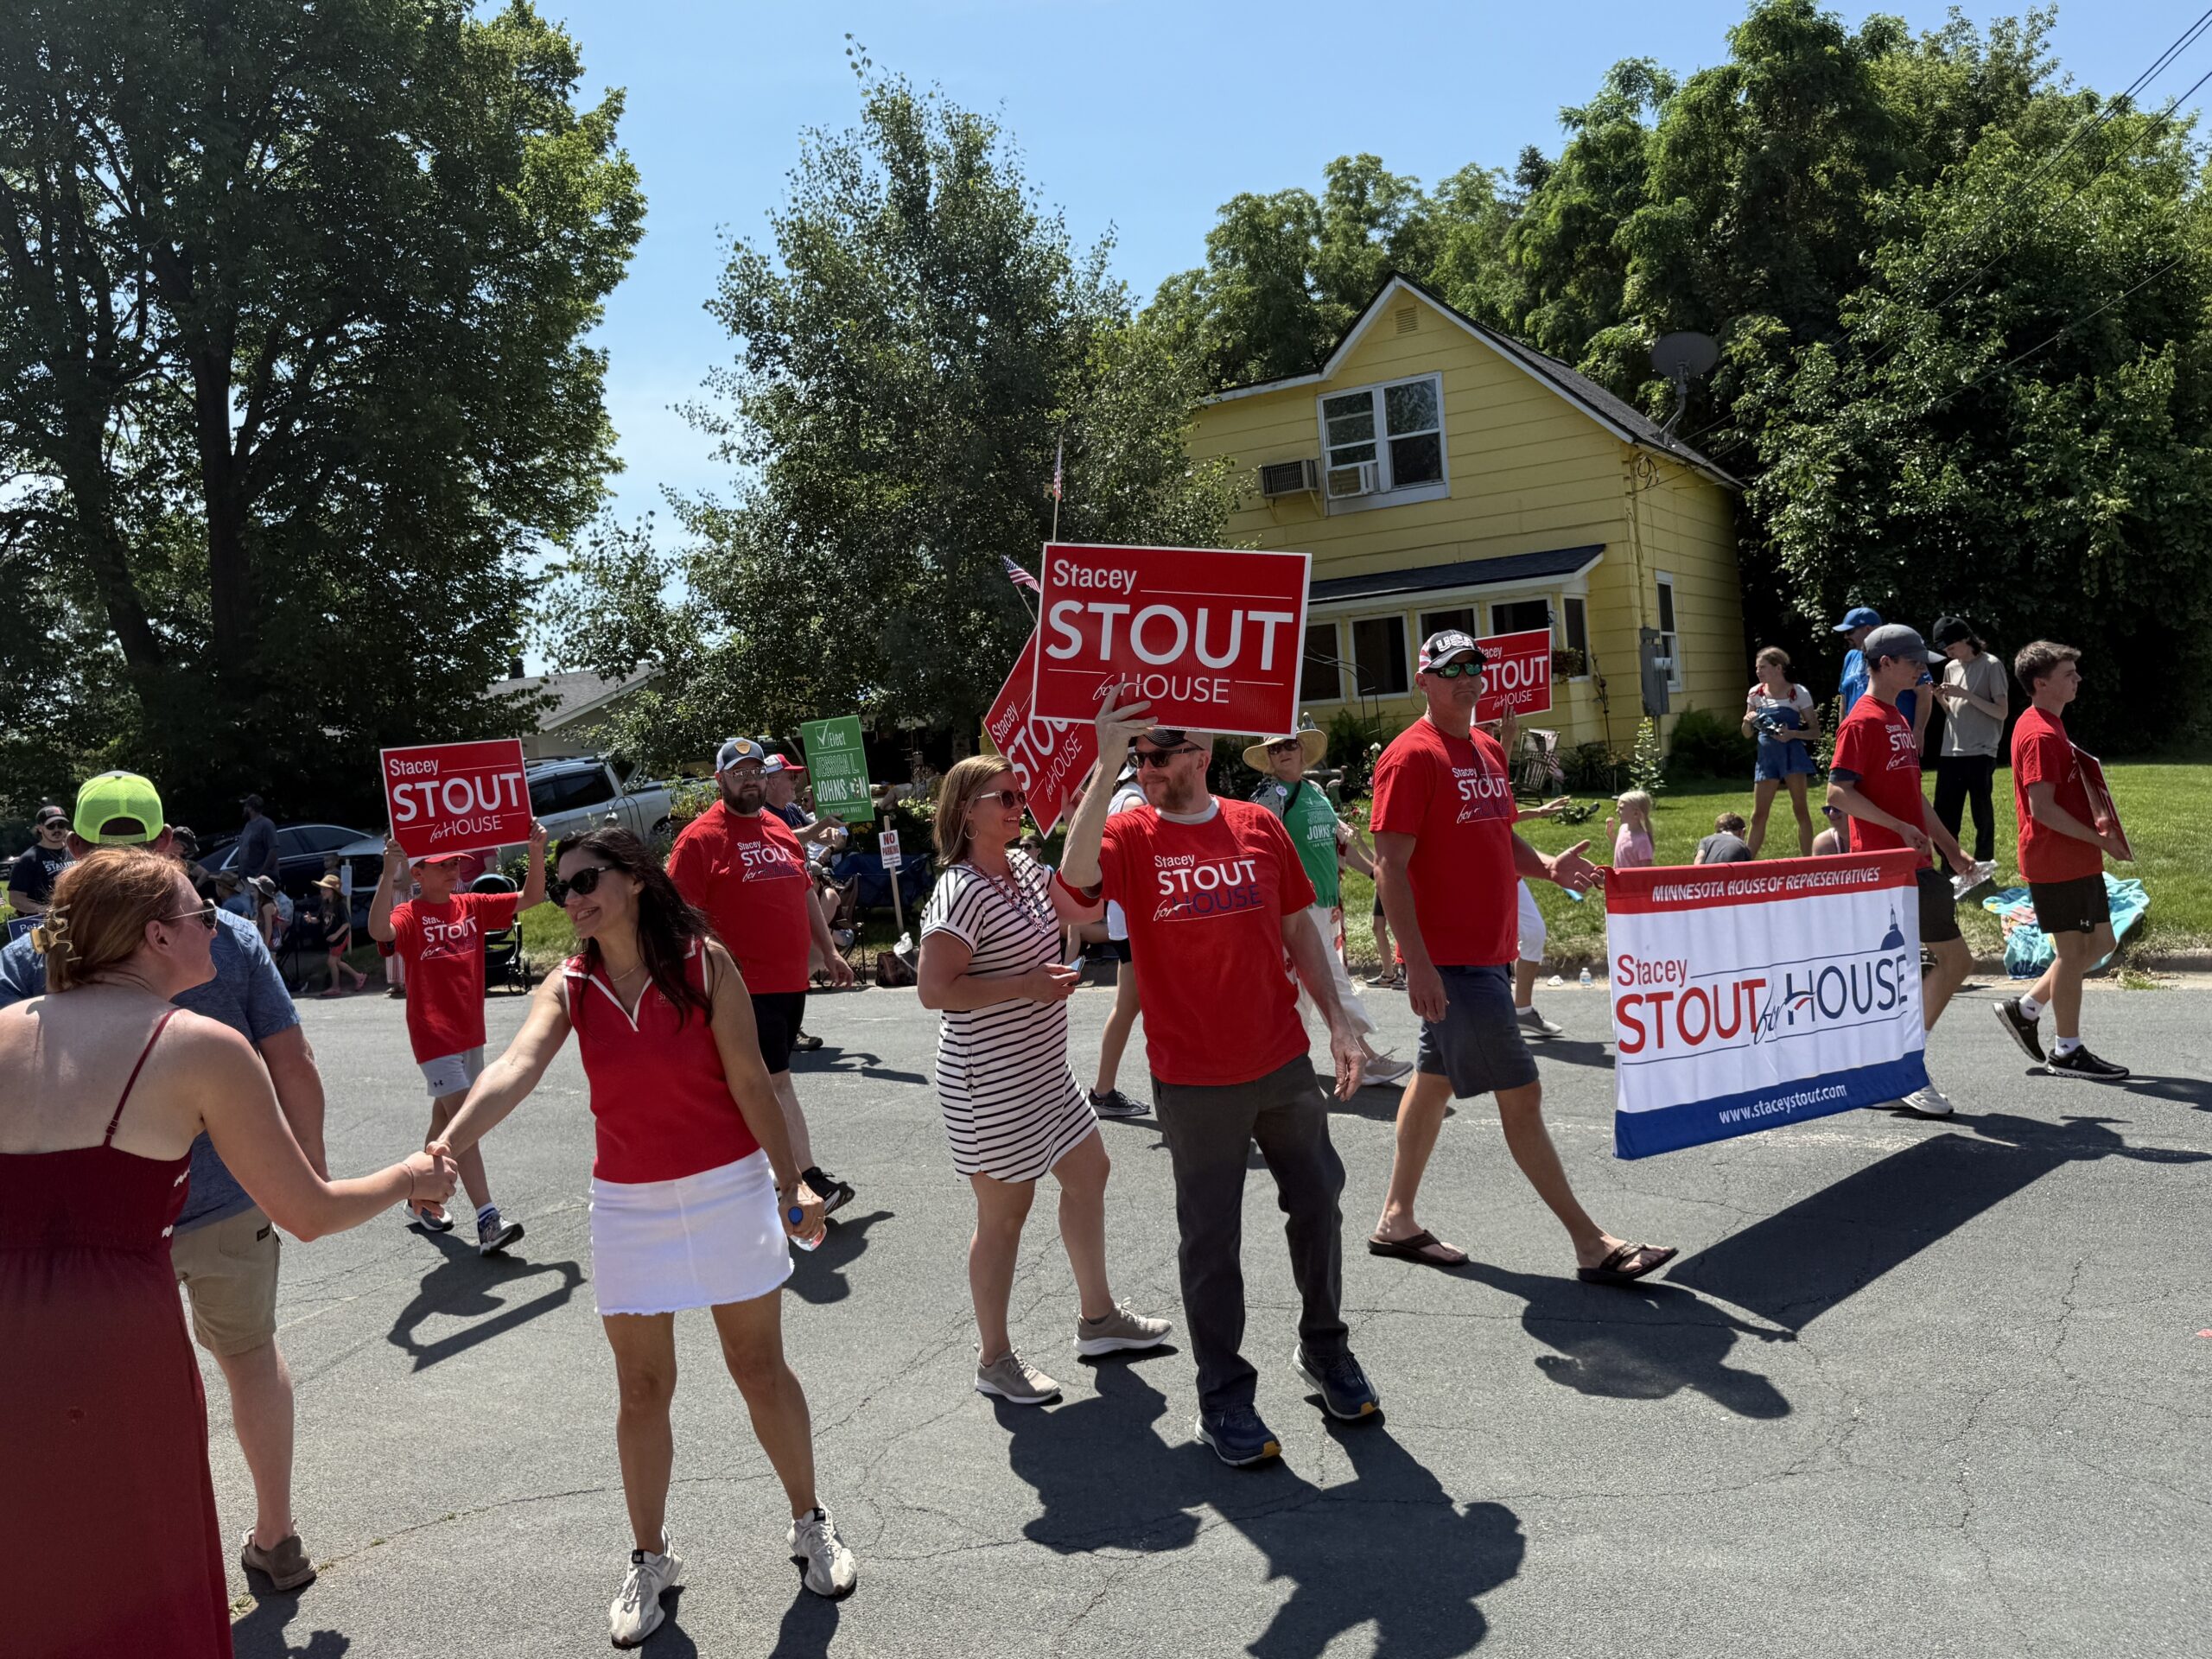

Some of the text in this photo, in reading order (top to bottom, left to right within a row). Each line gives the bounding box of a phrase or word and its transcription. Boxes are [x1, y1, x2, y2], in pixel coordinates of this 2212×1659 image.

[1052, 559, 1137, 595] Stacey
[1045, 600, 1294, 671] STOUT
[1435, 633, 1475, 652] USA
[1092, 673, 1230, 704] fo HOUSE
[1500, 690, 1533, 706] HOUSE
[991, 701, 1020, 743] Stacey
[829, 730, 846, 747] Elect
[389, 759, 439, 777] Stacey
[1046, 731, 1083, 788] HOUSE
[1452, 767, 1477, 779] Stacey
[392, 772, 521, 822] STOUT
[1458, 778, 1508, 801] STOUT
[1456, 804, 1476, 823] for
[429, 815, 503, 843] for HOUSE
[883, 832, 895, 845] NO
[737, 841, 760, 851] Stacey
[1154, 855, 1195, 868] Stacey
[1158, 860, 1255, 896] STOUT
[1652, 867, 1881, 903] MINNESOTA HOUSE OF REPRESENTATIVES
[1153, 884, 1263, 922] for HOUSE
[423, 916, 477, 943] STOUT
[1617, 954, 1688, 988] Stacey
[1616, 954, 1908, 1055] STOUT for HOUSE
[1719, 1084, 1847, 1124] www.staceystout.com
